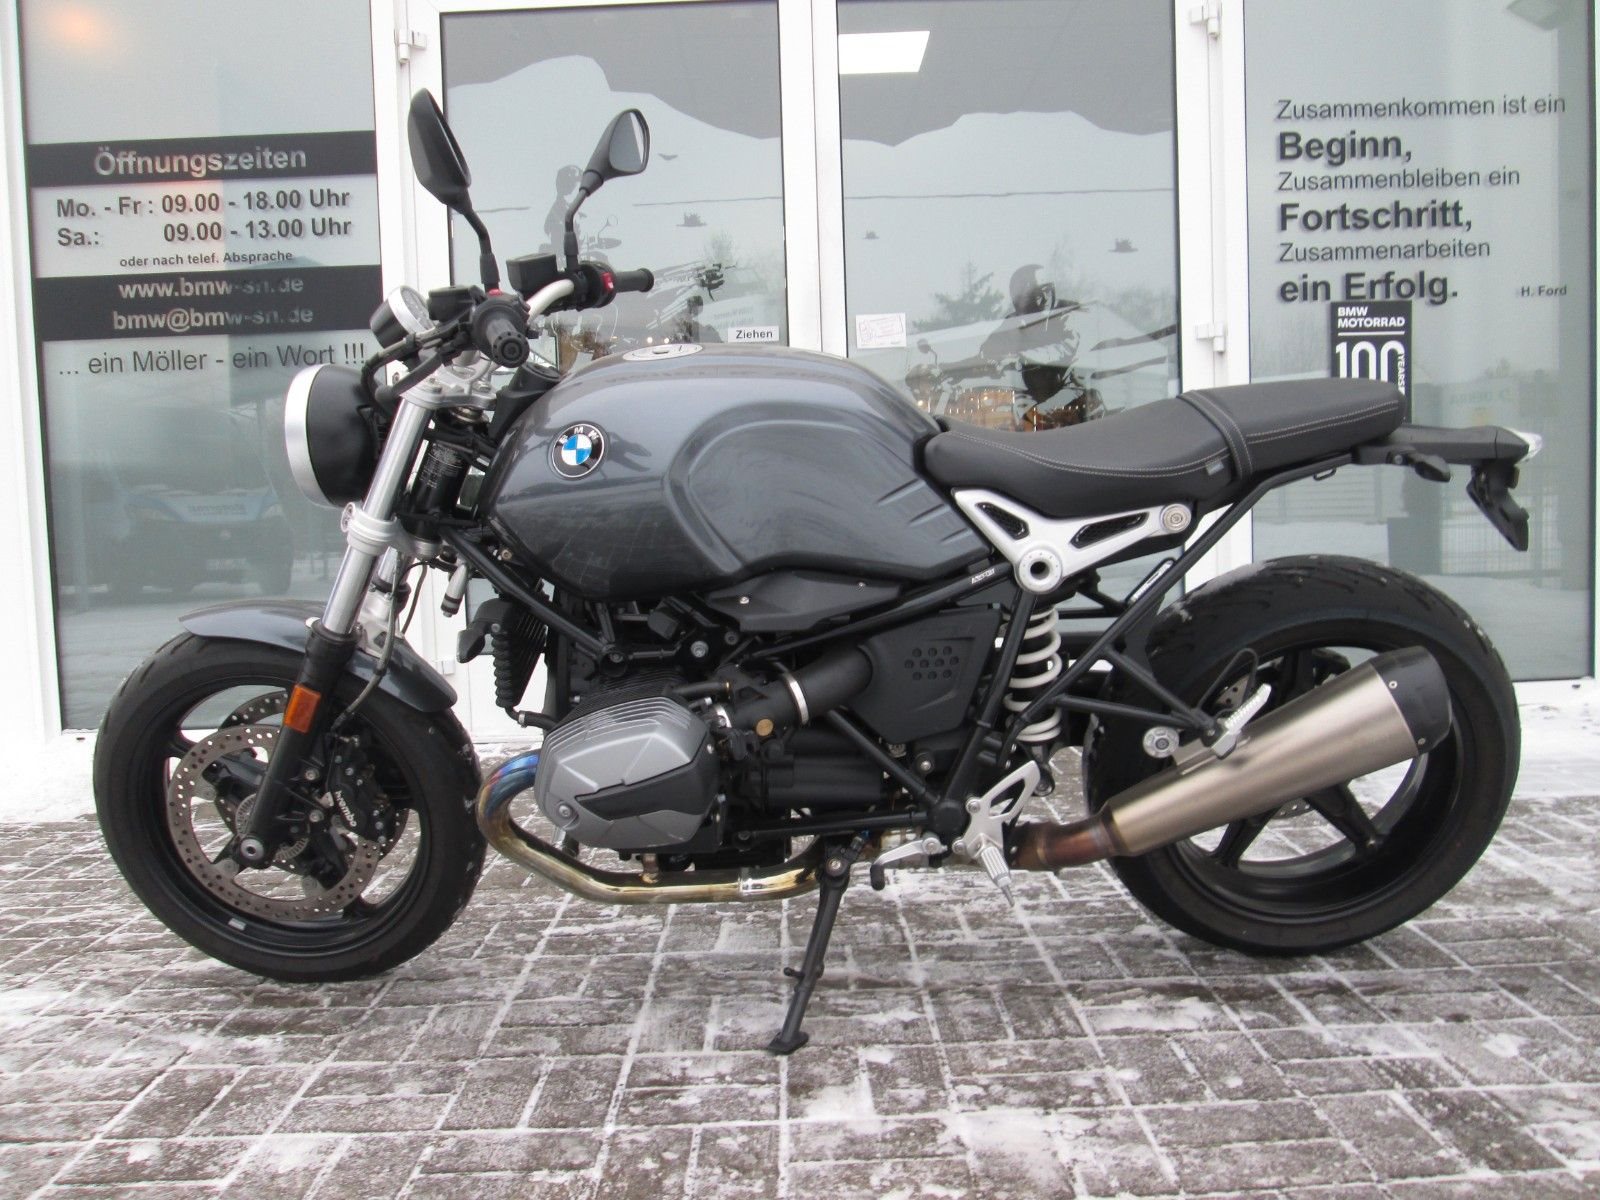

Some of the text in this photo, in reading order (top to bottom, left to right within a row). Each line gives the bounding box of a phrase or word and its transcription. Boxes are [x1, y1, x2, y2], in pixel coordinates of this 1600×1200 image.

[1277, 94, 1566, 120] Zusammenkommen ist ein
[94, 145, 307, 178] Öffnungszeiten
[1278, 131, 1412, 167] Beginn,
[1278, 166, 1520, 192] Zusammenbleiben ein
[56, 198, 96, 218] Mo.
[162, 193, 220, 213] 09.00
[243, 189, 301, 210] 18.00
[309, 188, 350, 208] Uhr
[1279, 199, 1472, 232] Fortschritt,
[163, 222, 222, 242] 09.00
[245, 218, 303, 239] 13.00
[311, 217, 352, 237] Uhr
[120, 250, 293, 267] oder nach telef. Absprache
[1279, 239, 1491, 263] Zusammenarbeiten
[1280, 271, 1458, 305] ein Erfolg.
[1521, 285, 1567, 297] H. Ford
[1337, 306, 1368, 317] BMW
[1337, 316, 1406, 328] MOTORRAD
[735, 329, 773, 339] Ziehen
[88, 352, 123, 374] ein
[133, 350, 207, 372] Möller
[232, 347, 268, 368] ein
[277, 344, 336, 367] Wort
[344, 343, 364, 364] !!!
[558, 426, 599, 444] BMW
[335, 790, 357, 827] brembo
